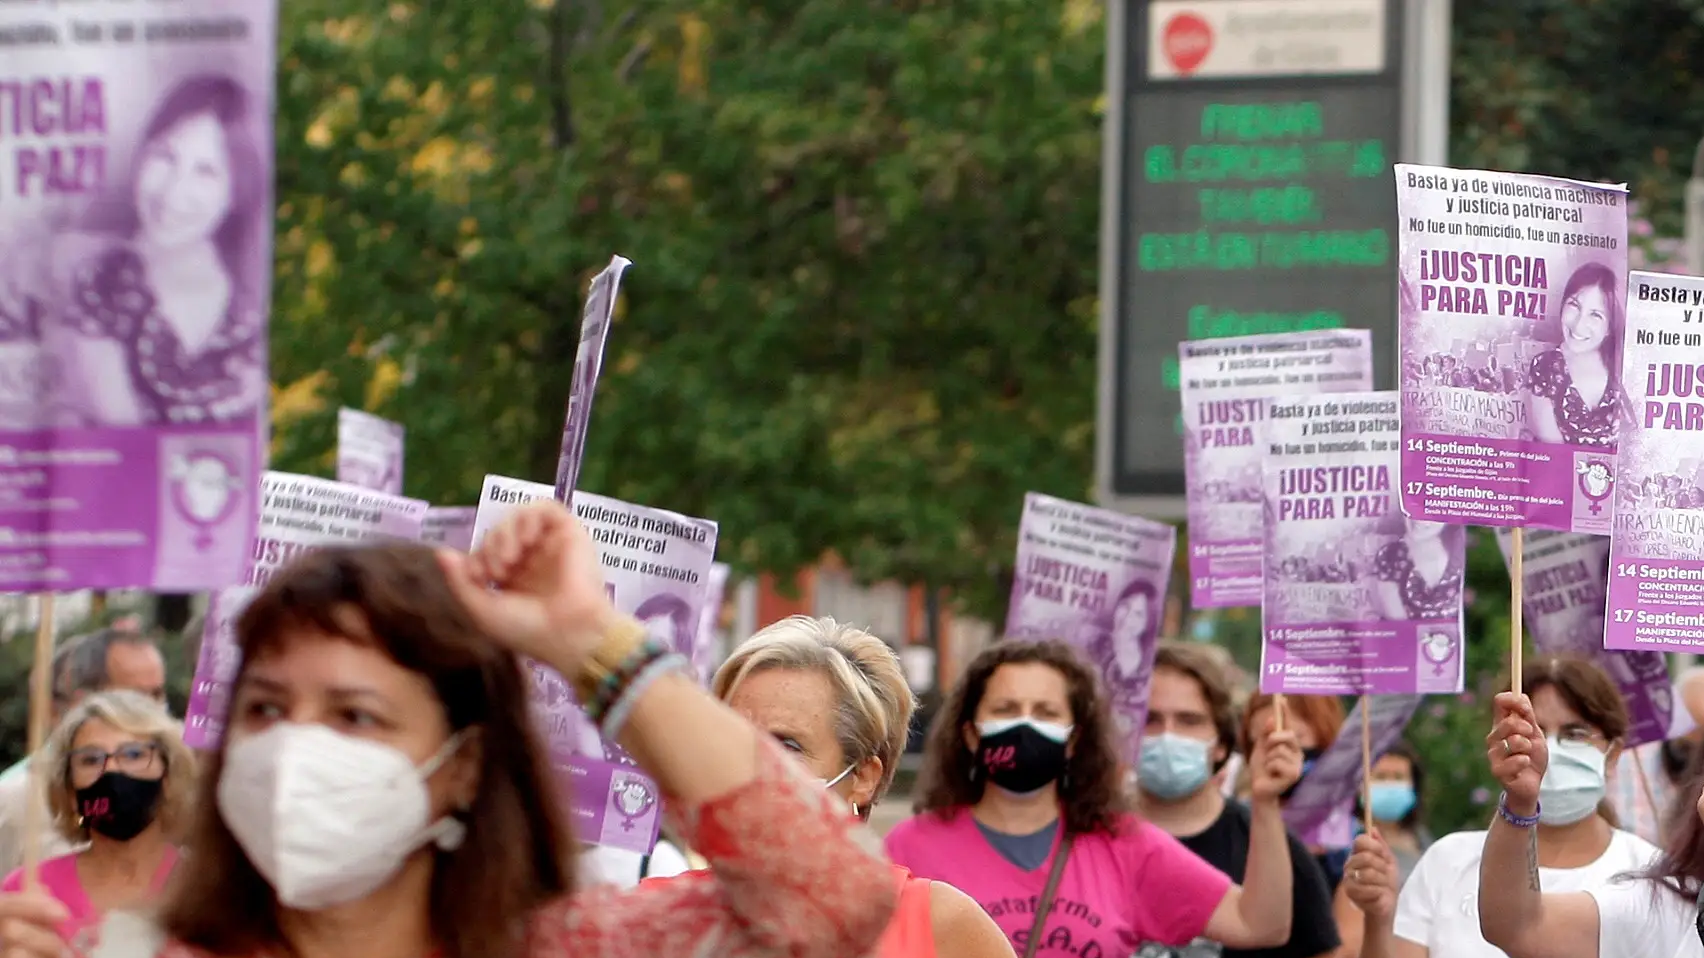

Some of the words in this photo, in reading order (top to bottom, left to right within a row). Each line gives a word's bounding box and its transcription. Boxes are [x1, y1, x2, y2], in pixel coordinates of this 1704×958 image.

[1408, 172, 1447, 190] Basta
[1452, 178, 1468, 193] ya
[1472, 177, 1488, 194] de
[1492, 180, 1551, 200] violencia
[1555, 187, 1617, 207] machista
[1446, 198, 1454, 213] y
[1458, 197, 1509, 216] justicia
[1513, 203, 1583, 223] patriarcal
[1409, 218, 1424, 232] No
[1427, 219, 1445, 234] fue
[1448, 223, 1462, 235] un
[1465, 222, 1525, 241] homicidio,
[1527, 227, 1544, 242] fue
[1547, 232, 1561, 244] un
[1562, 231, 1617, 250] asesinato
[1420, 249, 1549, 290] ¡JUSTICIA
[1420, 284, 1488, 315] PARA
[1497, 289, 1546, 321] PAZ!
[1638, 283, 1686, 304] Basta
[1682, 310, 1692, 323] y
[1637, 329, 1654, 346] No
[1658, 331, 1680, 346] fue
[1685, 334, 1700, 347] un
[1270, 402, 1304, 419] Basta
[1308, 403, 1321, 418] ya
[1324, 402, 1339, 416] de
[1341, 399, 1396, 415] violencia
[1201, 426, 1254, 449] PARA
[1302, 422, 1309, 436] y
[1311, 419, 1355, 434] justicia
[1407, 438, 1423, 452] 14
[1426, 440, 1497, 457] Septiembre.
[1426, 455, 1488, 469] CONCENTRACIÓN
[1279, 465, 1390, 496] ¡JUSTICIA
[1407, 481, 1424, 495] 17
[1425, 483, 1497, 500] Septiembre.
[490, 484, 531, 505] Basta
[1279, 496, 1335, 521] PARA
[1344, 495, 1390, 518] PAZ!
[576, 502, 640, 529] violencia
[642, 516, 707, 543] machista
[592, 527, 667, 555] patriarcal
[601, 552, 620, 568] fue
[624, 558, 637, 571] un
[640, 562, 699, 584] asesinato
[1617, 563, 1637, 578] 14
[1614, 609, 1634, 623] 17
